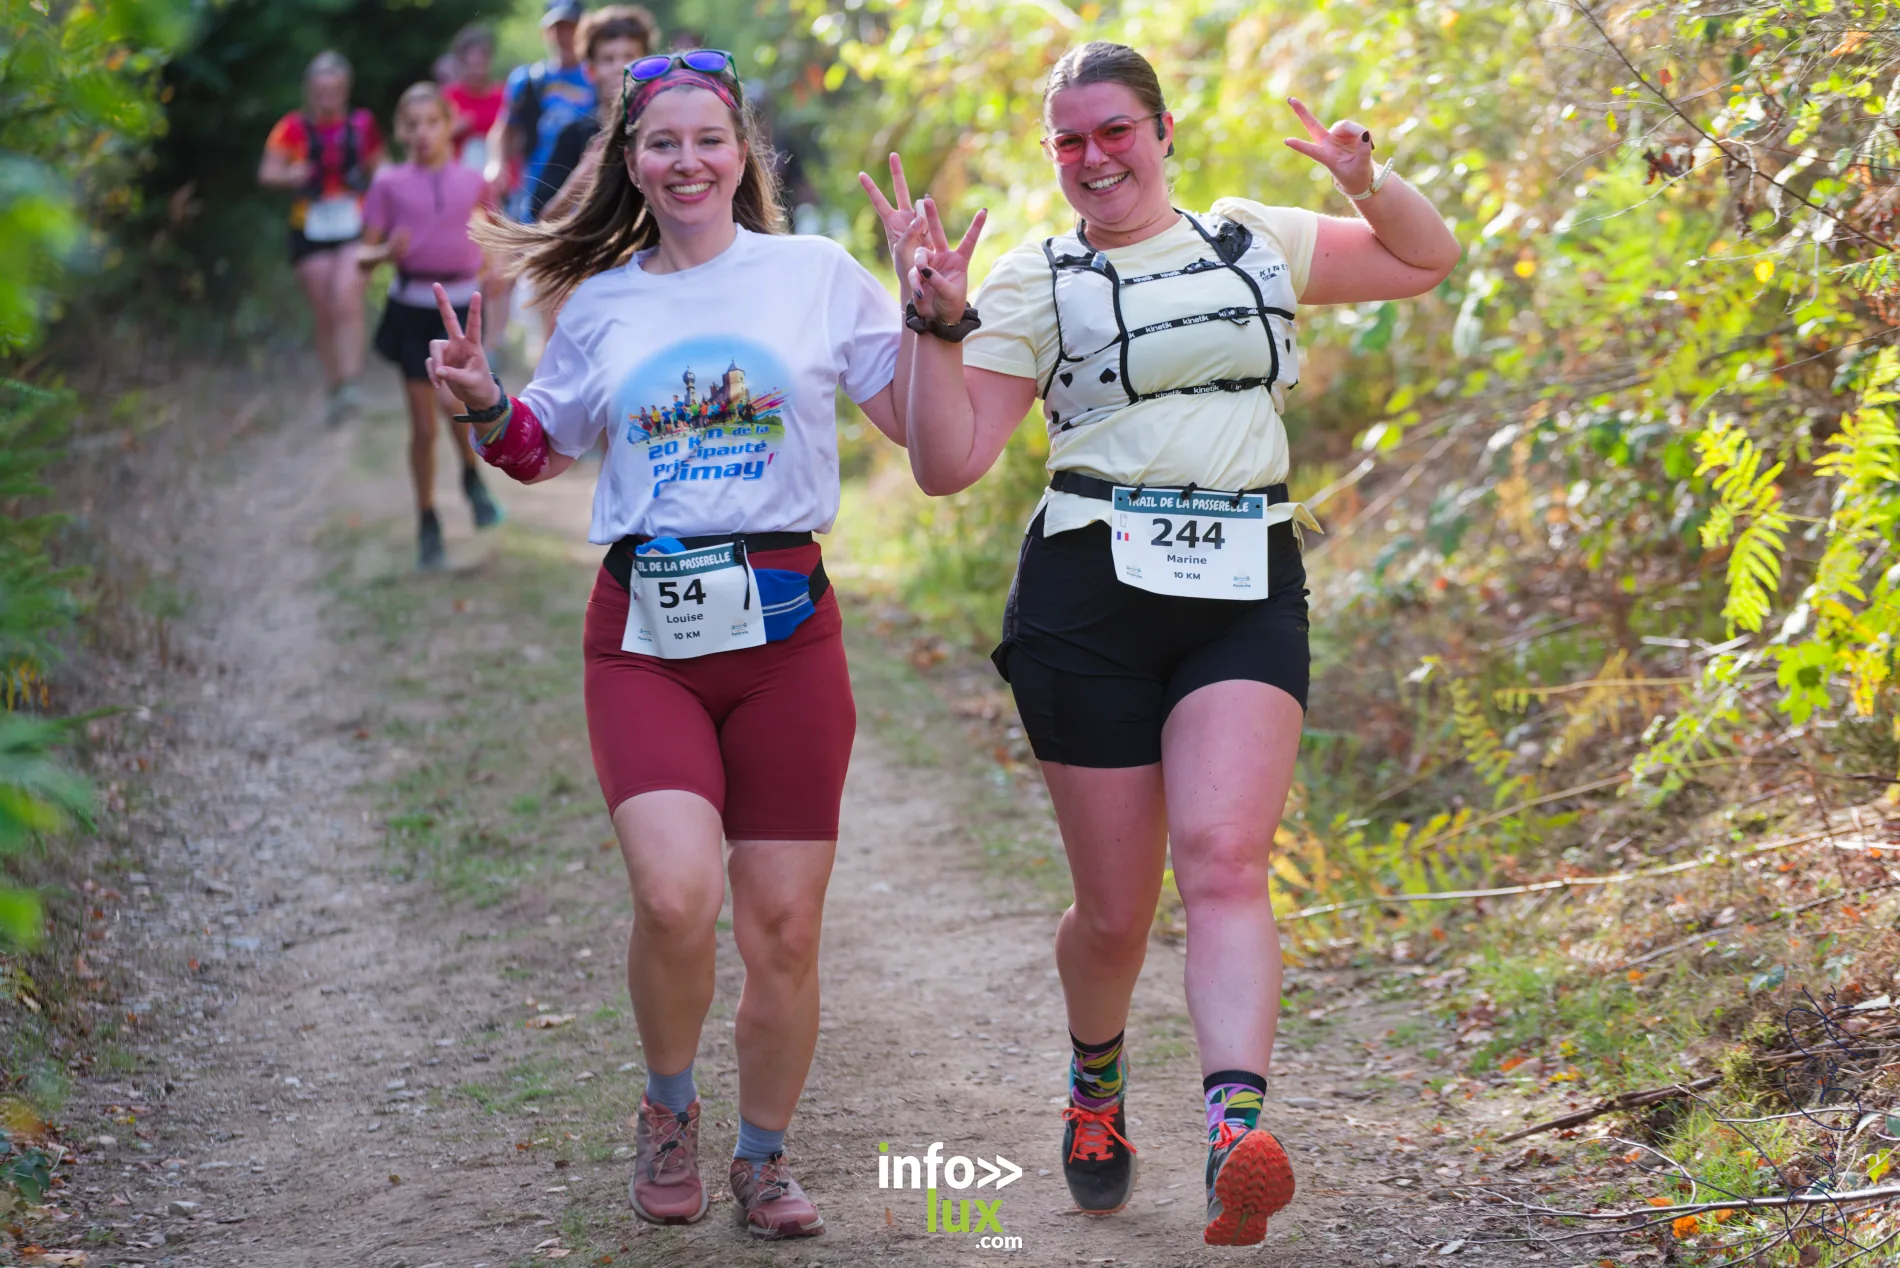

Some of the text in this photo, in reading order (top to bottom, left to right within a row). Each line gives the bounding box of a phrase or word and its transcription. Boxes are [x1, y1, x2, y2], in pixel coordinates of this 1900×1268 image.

[1145, 322, 1173, 333] kinetik
[1182, 315, 1209, 325] kinetik
[1193, 385, 1220, 394] kinetik
[648, 440, 679, 460] 20
[732, 427, 752, 436] de
[756, 425, 769, 435] la
[1160, 497, 1173, 508] DE
[1176, 498, 1190, 509] LA
[1193, 498, 1249, 513] PASSERELLE
[1151, 518, 1226, 550] 244
[649, 562, 663, 572] DE
[664, 561, 678, 572] LA
[680, 551, 731, 571] PASSERELLE
[1167, 554, 1207, 565] Marine
[1174, 571, 1200, 580] 10 KM
[658, 578, 707, 609] 54
[666, 613, 704, 624] Louise
[673, 630, 701, 640] 10 KM
